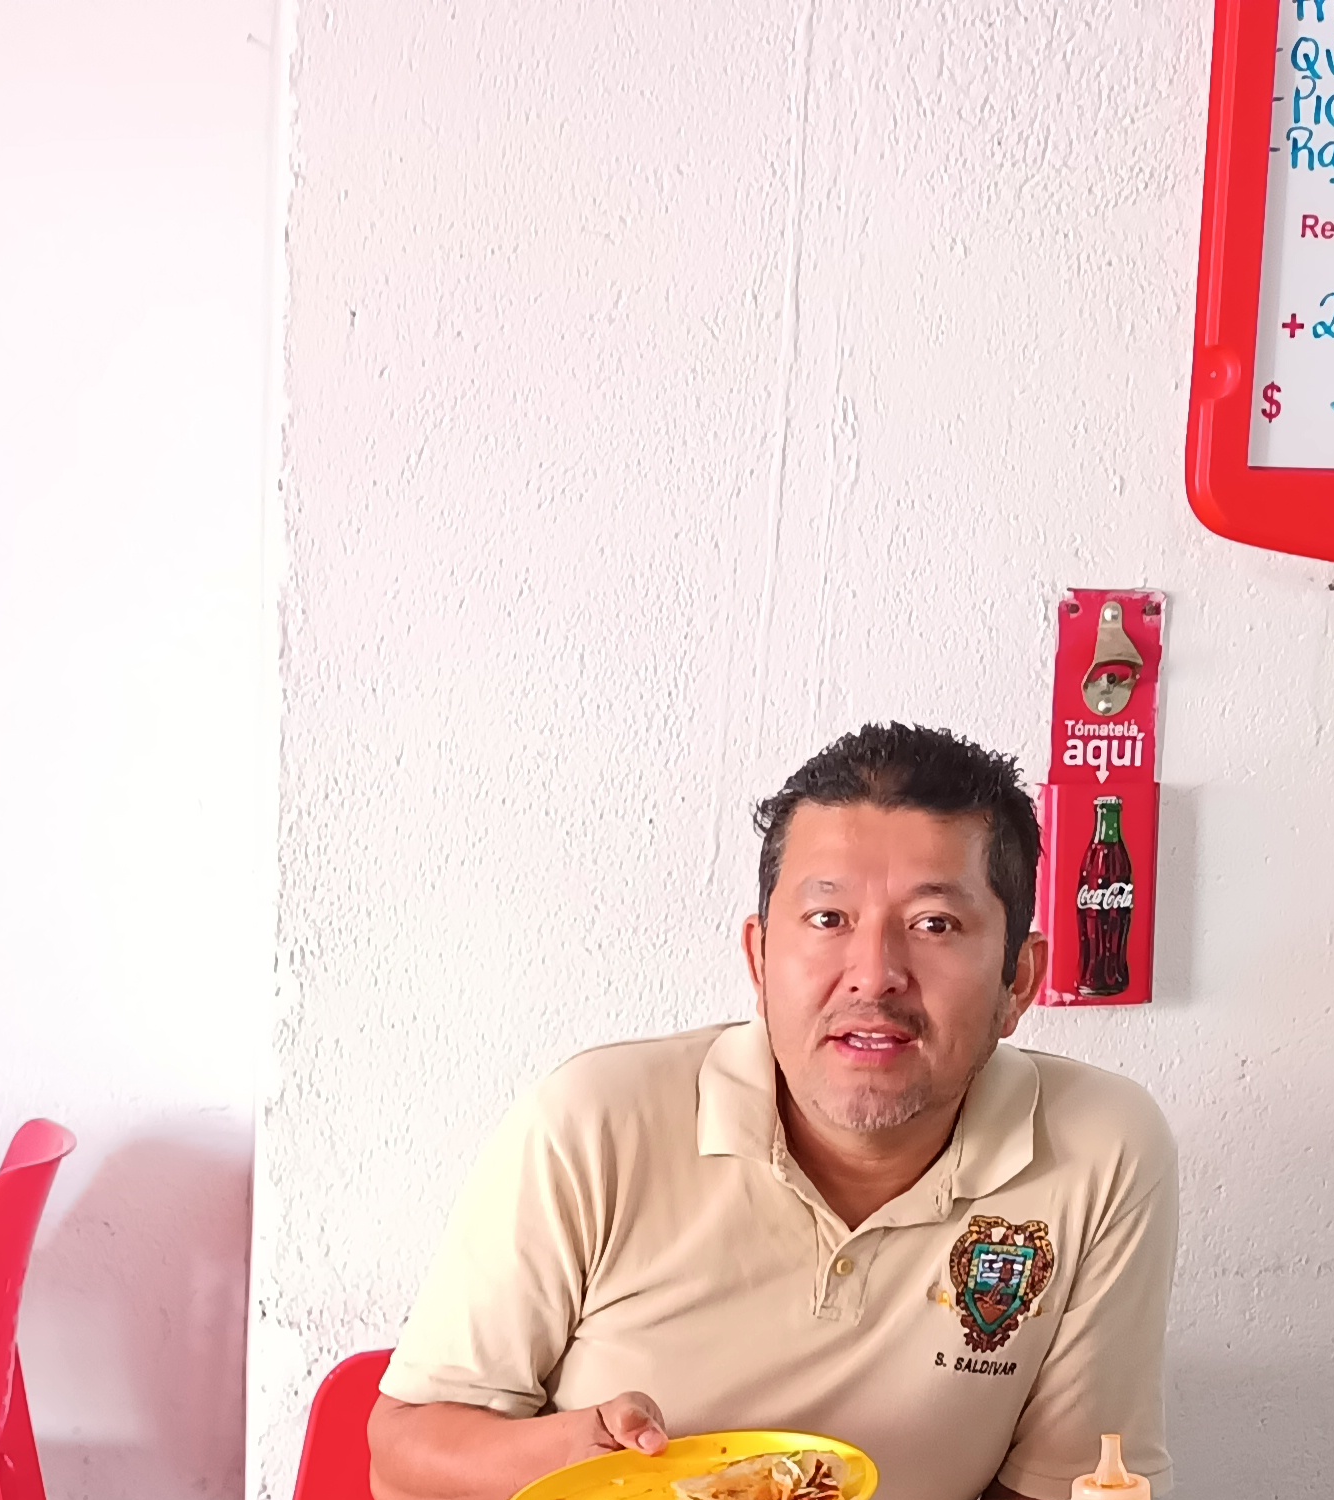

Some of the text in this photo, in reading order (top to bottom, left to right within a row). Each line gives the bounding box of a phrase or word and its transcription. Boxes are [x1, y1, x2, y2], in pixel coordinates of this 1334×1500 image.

[1063, 733, 1145, 775] aquí
[934, 1352, 1017, 1376] S. SALDIVAR
